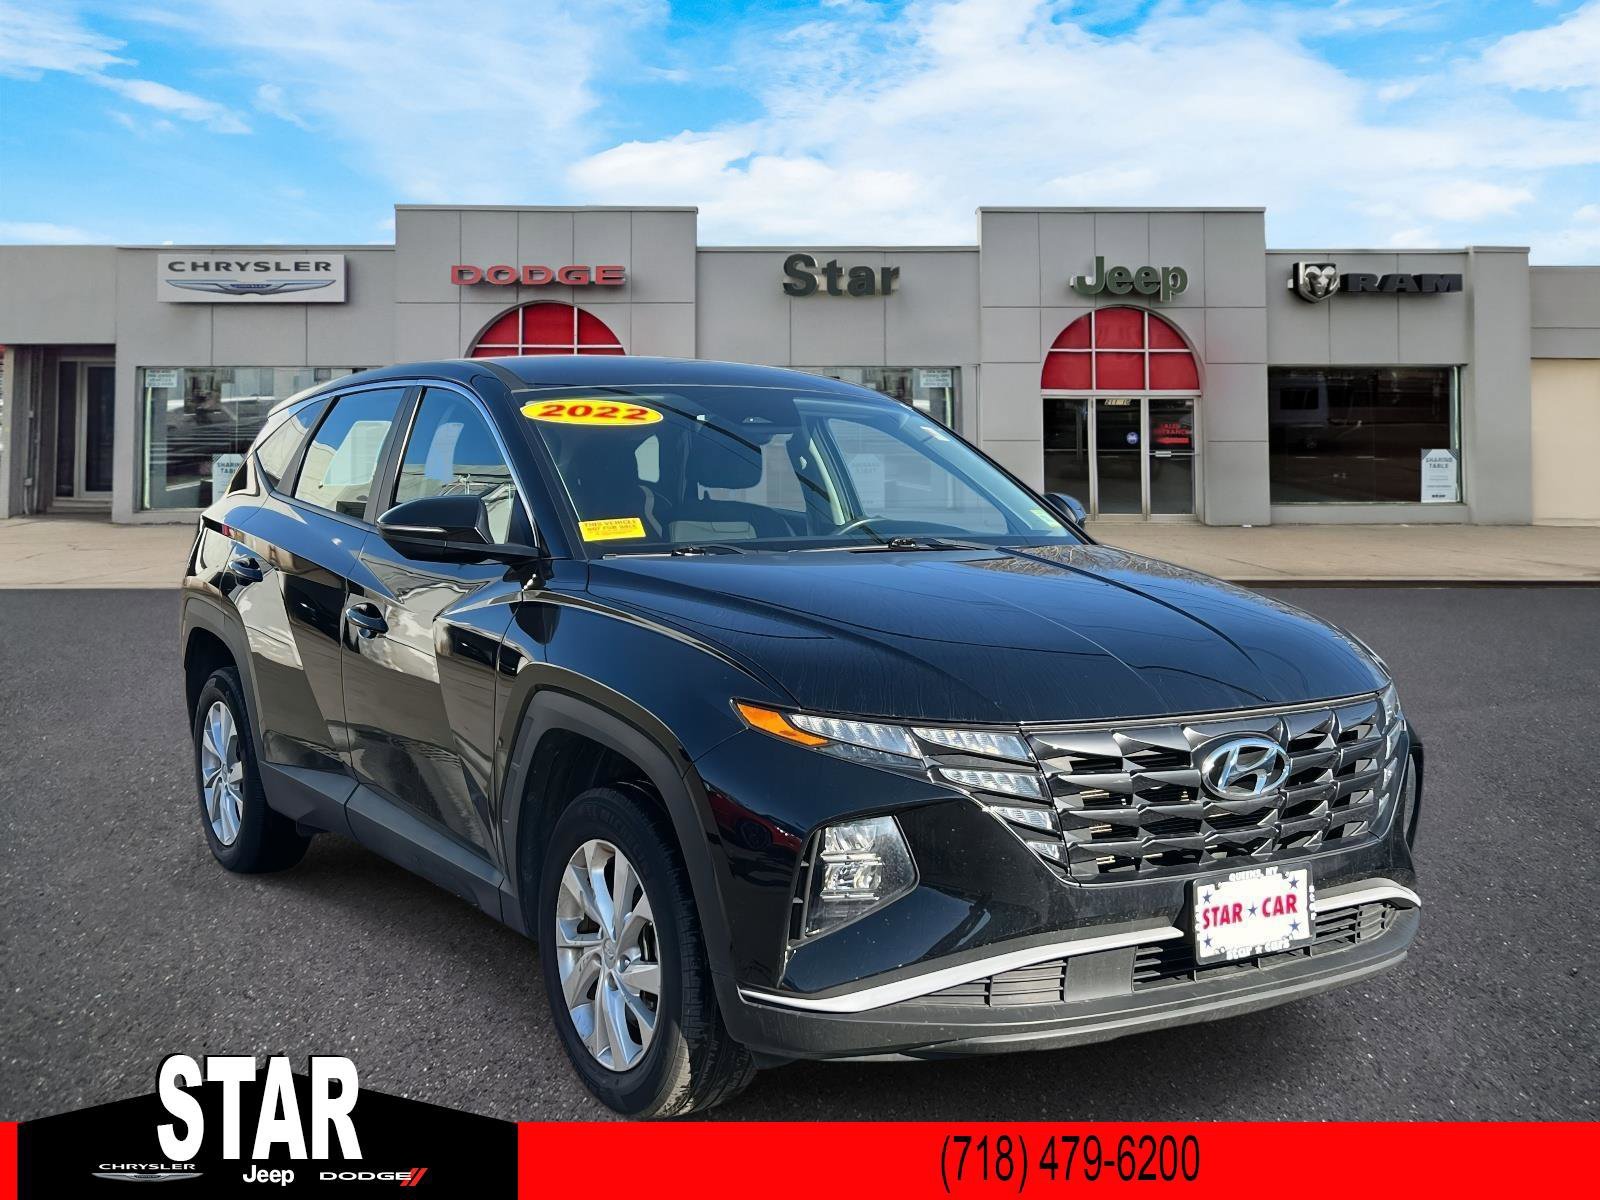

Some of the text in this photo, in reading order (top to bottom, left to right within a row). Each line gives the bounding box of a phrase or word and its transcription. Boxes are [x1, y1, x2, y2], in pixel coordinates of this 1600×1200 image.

[168, 261, 332, 272] CHRYSLER
[451, 265, 626, 286] DODGE
[783, 253, 900, 297] Star
[1072, 256, 1188, 301] Jeep
[1345, 274, 1463, 292] RAM
[537, 404, 649, 420] 2022
[1202, 902, 1243, 930] STAR
[1262, 893, 1298, 918] CAR
